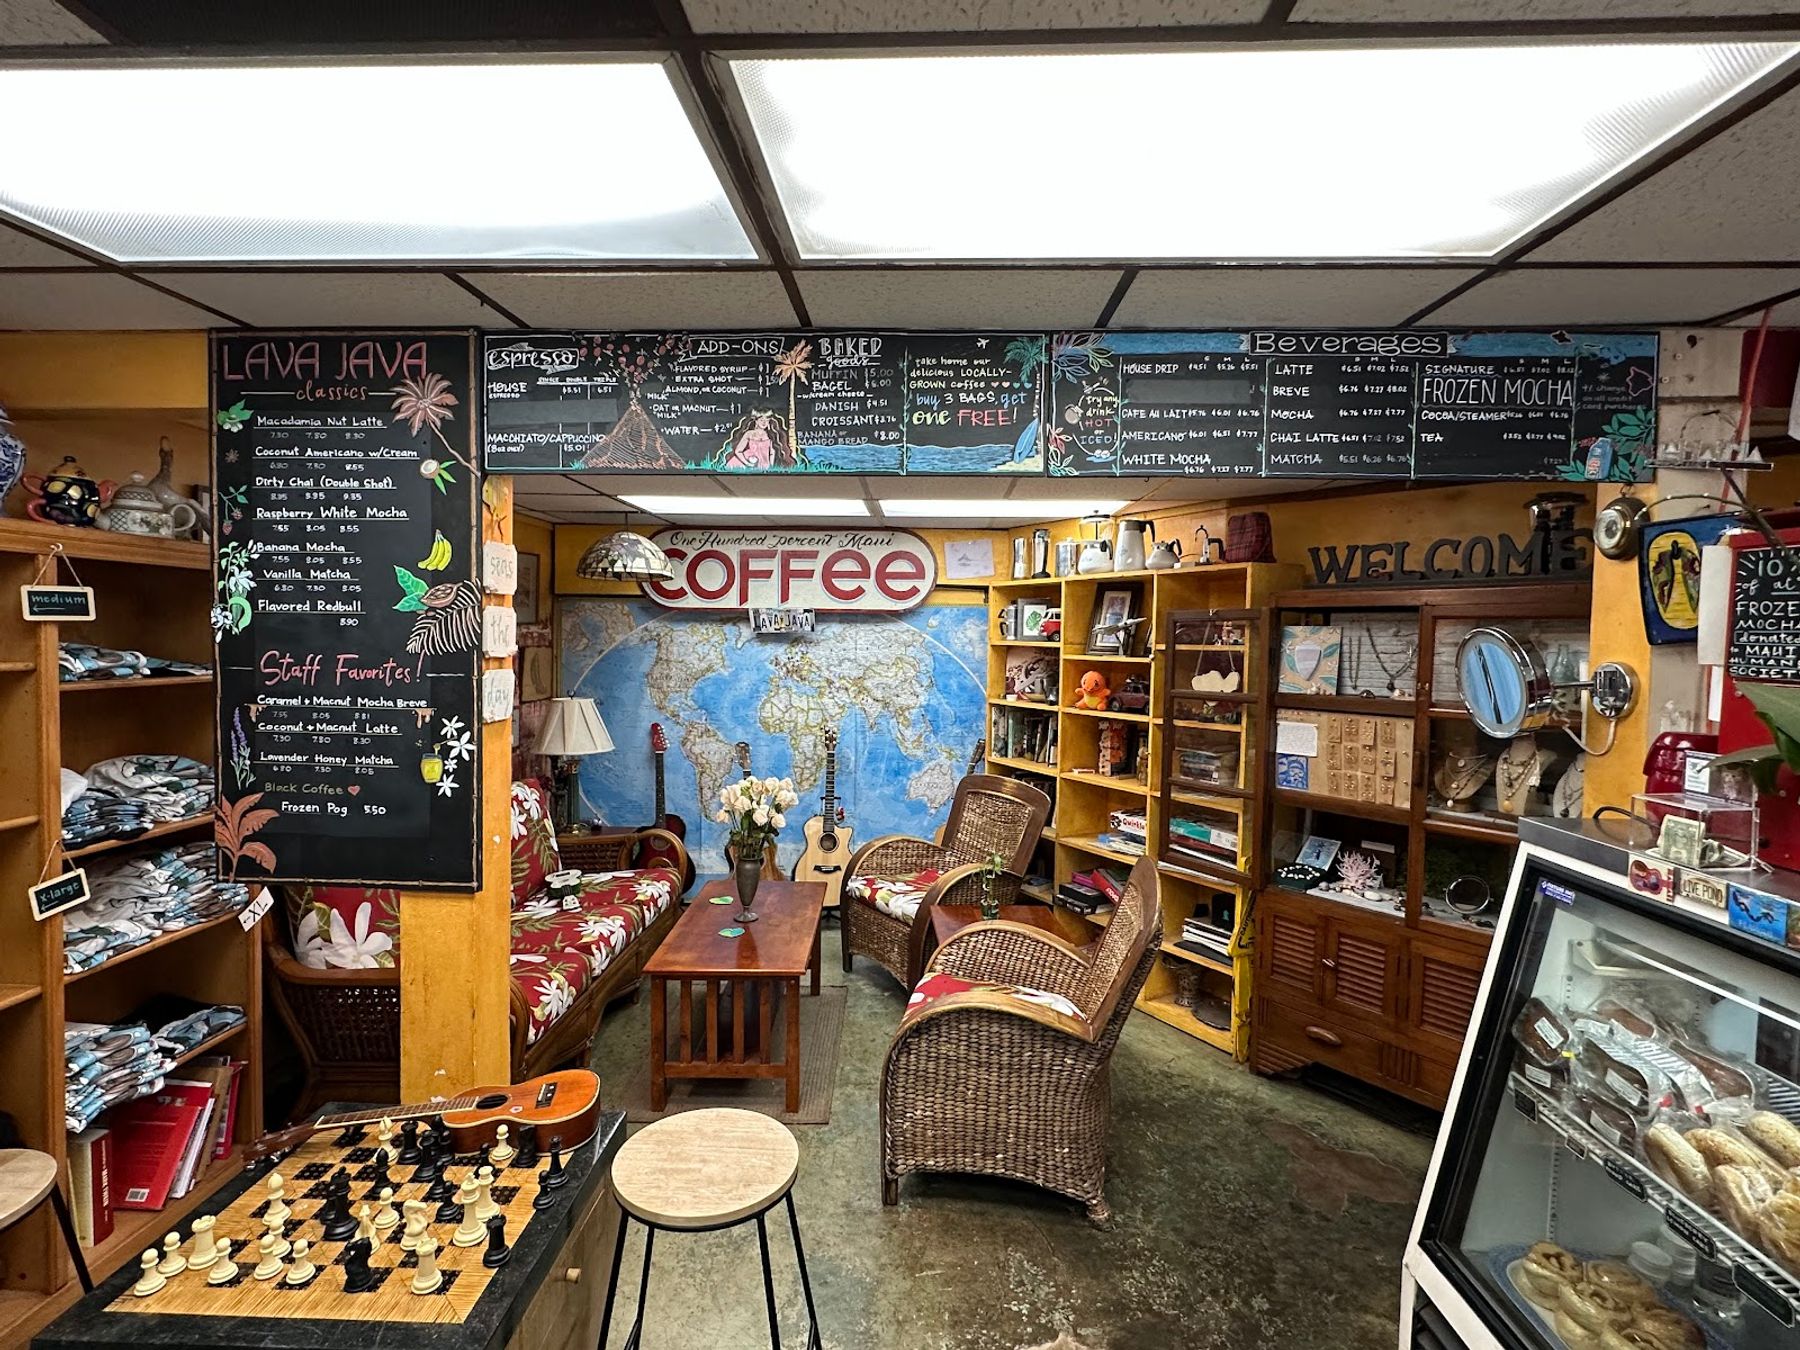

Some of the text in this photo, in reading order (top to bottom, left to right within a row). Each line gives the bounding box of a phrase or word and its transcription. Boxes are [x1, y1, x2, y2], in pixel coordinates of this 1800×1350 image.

[698, 340, 779, 354] ADD-ONS
[819, 338, 881, 355] BAKED
[1255, 333, 1441, 356] Beverages
[222, 342, 427, 380] LAVA JAVA
[489, 350, 575, 369] espresso
[826, 354, 869, 369] goods
[941, 357, 968, 366] home
[811, 368, 857, 379] MUFFIN
[910, 369, 953, 377] delicious
[1123, 364, 1151, 374] HOUSE
[1155, 364, 1178, 374] DRIP
[1275, 365, 1313, 375] LATTE
[1426, 364, 1495, 374] SIGNATURE
[488, 382, 527, 393] HOUSE
[712, 386, 747, 394] COCONUT
[812, 381, 852, 392] BAGEL
[910, 380, 985, 389] GROWN coffee
[296, 380, 368, 401] classics
[1273, 387, 1310, 397] BREVE
[1422, 379, 1572, 405] FROZEN MOCHA
[916, 394, 940, 406] buy
[1001, 392, 1027, 409] get
[652, 404, 716, 413] OAT MACNUT
[815, 402, 858, 411] DANISH
[1086, 407, 1114, 417] drink
[912, 407, 1017, 426] one FREE!
[1122, 409, 1146, 418] CAFE
[1164, 409, 1187, 419] LAIT
[1271, 410, 1314, 419] MOCHA
[257, 416, 383, 427] Macadamia Nut Latte
[812, 415, 875, 426] CROISSANT
[1085, 419, 1112, 427] HOT
[665, 426, 699, 435] WATER
[797, 430, 837, 438] BANANA
[1122, 431, 1186, 441] AMERICANO
[838, 437, 868, 445] BREAD
[1271, 433, 1339, 443] CHAI LATTE
[1421, 433, 1443, 442] TEA
[255, 447, 417, 458] Coconut Americano w/Cream
[1123, 453, 1211, 465] WHITE MOCHA
[1271, 454, 1322, 464] MATCHA
[256, 477, 393, 489] Dirty Chai (Double Shot)
[256, 507, 407, 519] Raspberry White Mocha
[257, 541, 346, 552] Banana Mocha
[670, 532, 894, 550] One Hundred percent Maui
[1308, 528, 1594, 583] WELCOME
[263, 569, 350, 580] Vanilla Matcha
[31, 594, 86, 604] medium
[258, 600, 361, 612] Flavored Redbull
[1746, 645, 1796, 658] MAUI
[260, 650, 424, 687] Staff Favorites!
[1729, 668, 1800, 678] SOCIET
[257, 695, 427, 708] Caramel Macnut Mocha Breve
[258, 722, 398, 733] Coconut Macnut Latte
[260, 753, 394, 767] Lavender Honey Matcha
[264, 782, 344, 795] Black Coffee
[281, 801, 320, 814] Frozen
[328, 802, 348, 816] Pog
[40, 881, 80, 902] X-large
[248, 902, 268, 923] XL
